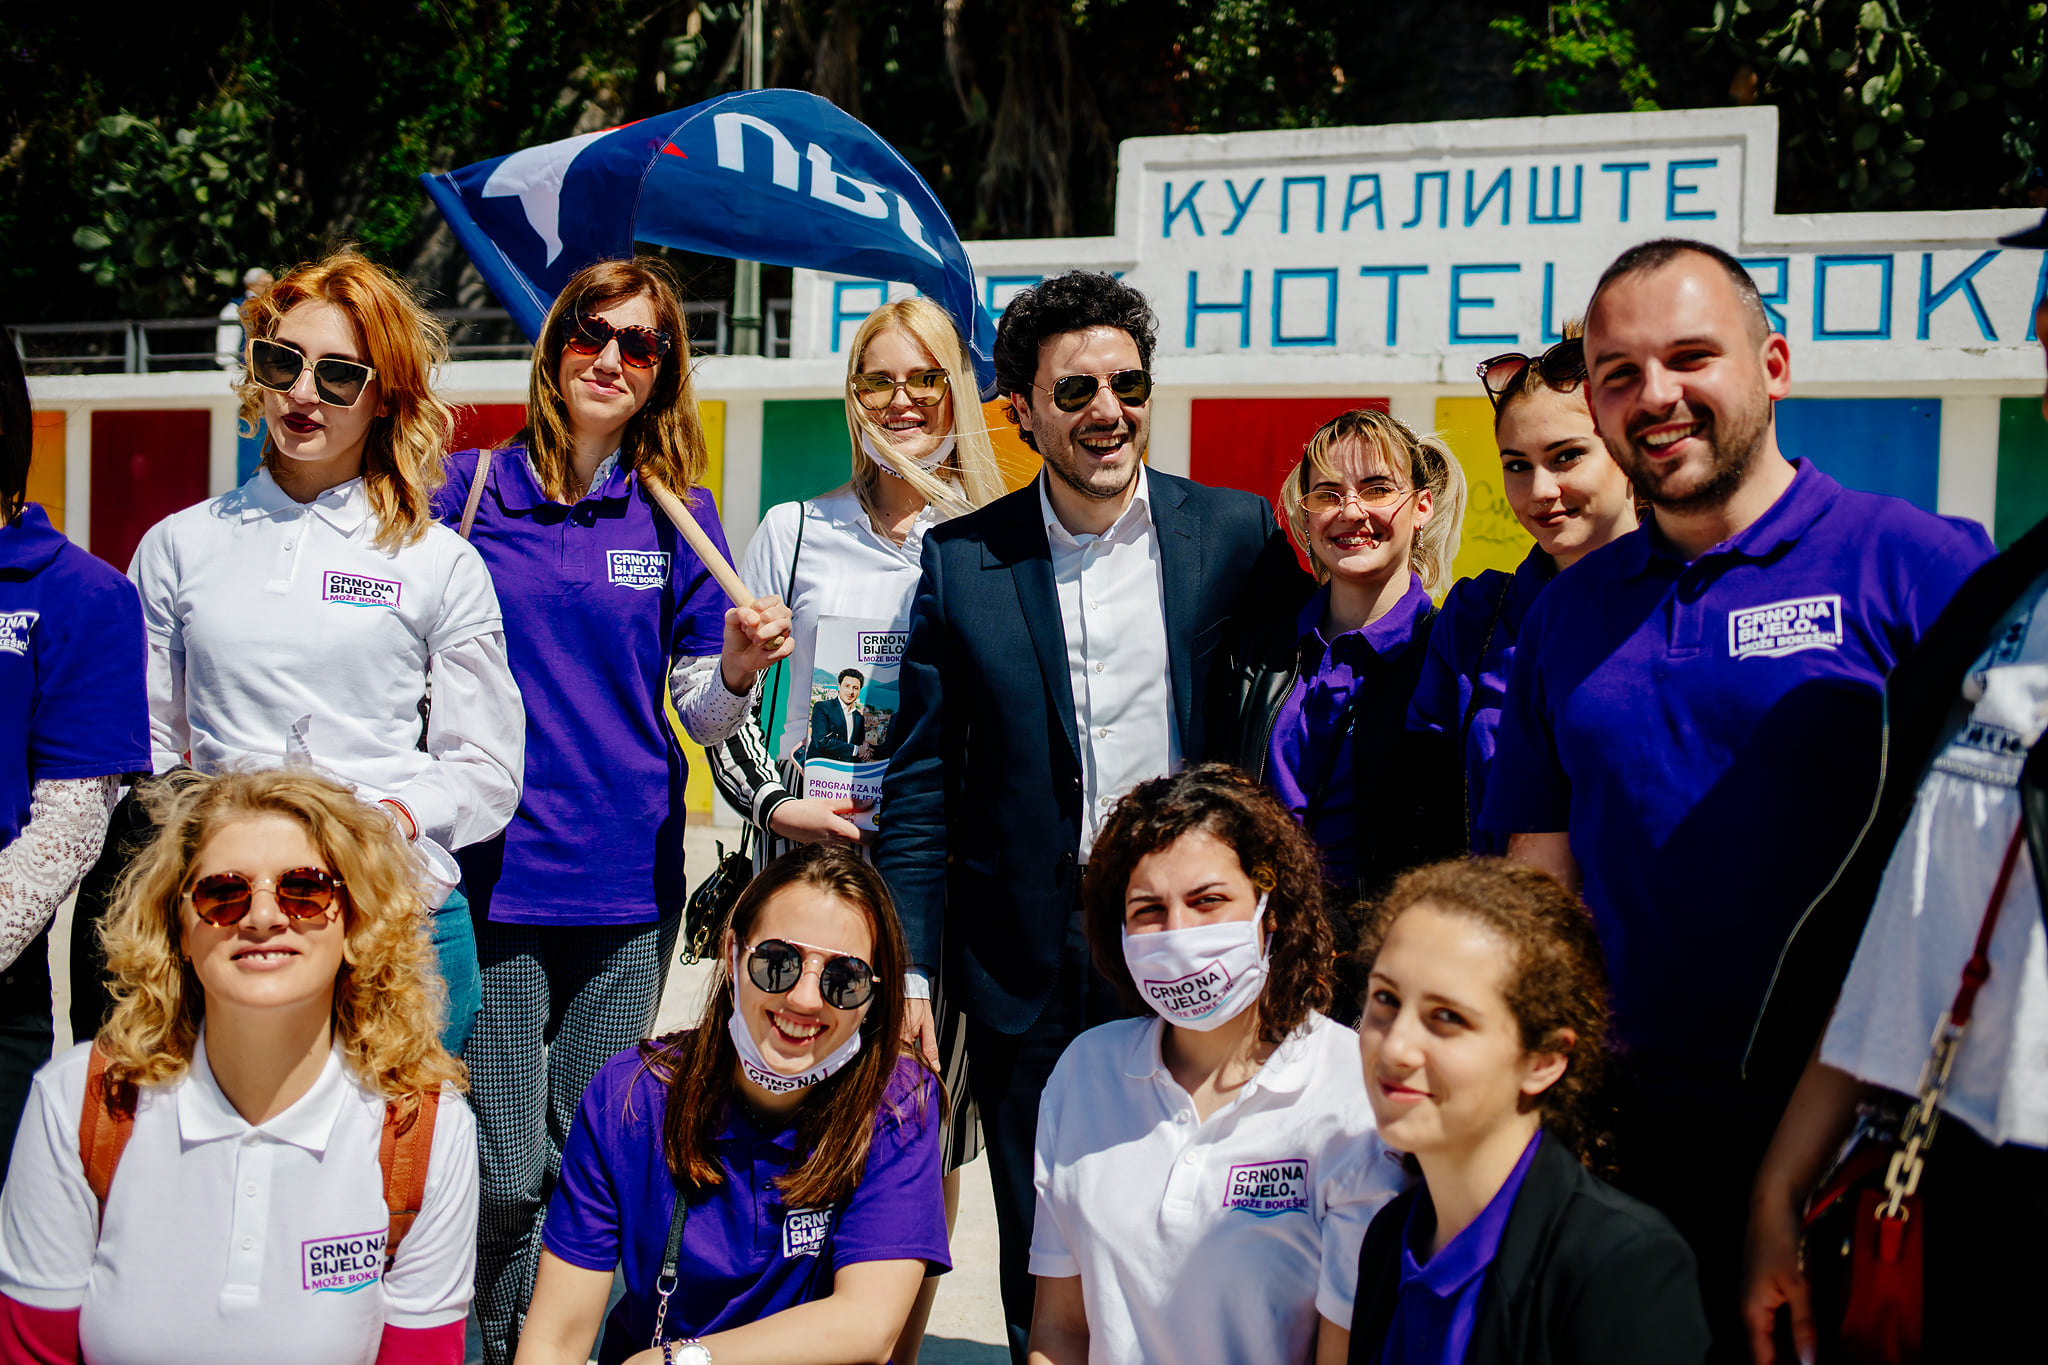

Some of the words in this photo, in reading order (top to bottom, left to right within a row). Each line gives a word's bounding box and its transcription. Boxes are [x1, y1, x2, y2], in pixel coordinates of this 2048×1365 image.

[1163, 159, 1718, 238] КУПАЛИШТЕ
[1185, 262, 1566, 348] HOTEL
[613, 554, 649, 566] CRNO
[649, 555, 667, 567] NA
[614, 564, 661, 576] BIJELO.
[330, 575, 373, 589] CRNO
[374, 582, 394, 594] NA
[330, 584, 386, 600] BIJELO.
[1738, 606, 1797, 628] CRNO
[1799, 602, 1831, 619] NA
[863, 635, 896, 645] CRNO
[897, 635, 906, 645] N
[1738, 618, 1819, 644] BIJELO.
[809, 779, 855, 792] PROGRAM
[856, 784, 870, 794] ZA
[809, 789, 834, 800] CRNO
[1150, 982, 1195, 999] CRNO
[1195, 972, 1221, 989] NA
[749, 1068, 795, 1088] CRNO
[797, 1073, 821, 1089] NA
[1236, 1167, 1280, 1183] CRNO
[1281, 1165, 1304, 1181] NA
[1233, 1182, 1296, 1198] BIJELO.
[1231, 1198, 1262, 1209] MOŽE
[789, 1210, 833, 1231] CRNO
[790, 1225, 826, 1246] BIJE
[310, 1240, 363, 1260] CRNO
[366, 1235, 386, 1253] NA
[311, 1254, 381, 1277] BIJELO.
[312, 1275, 345, 1289] MOŽE
[348, 1269, 379, 1283] BOKE
